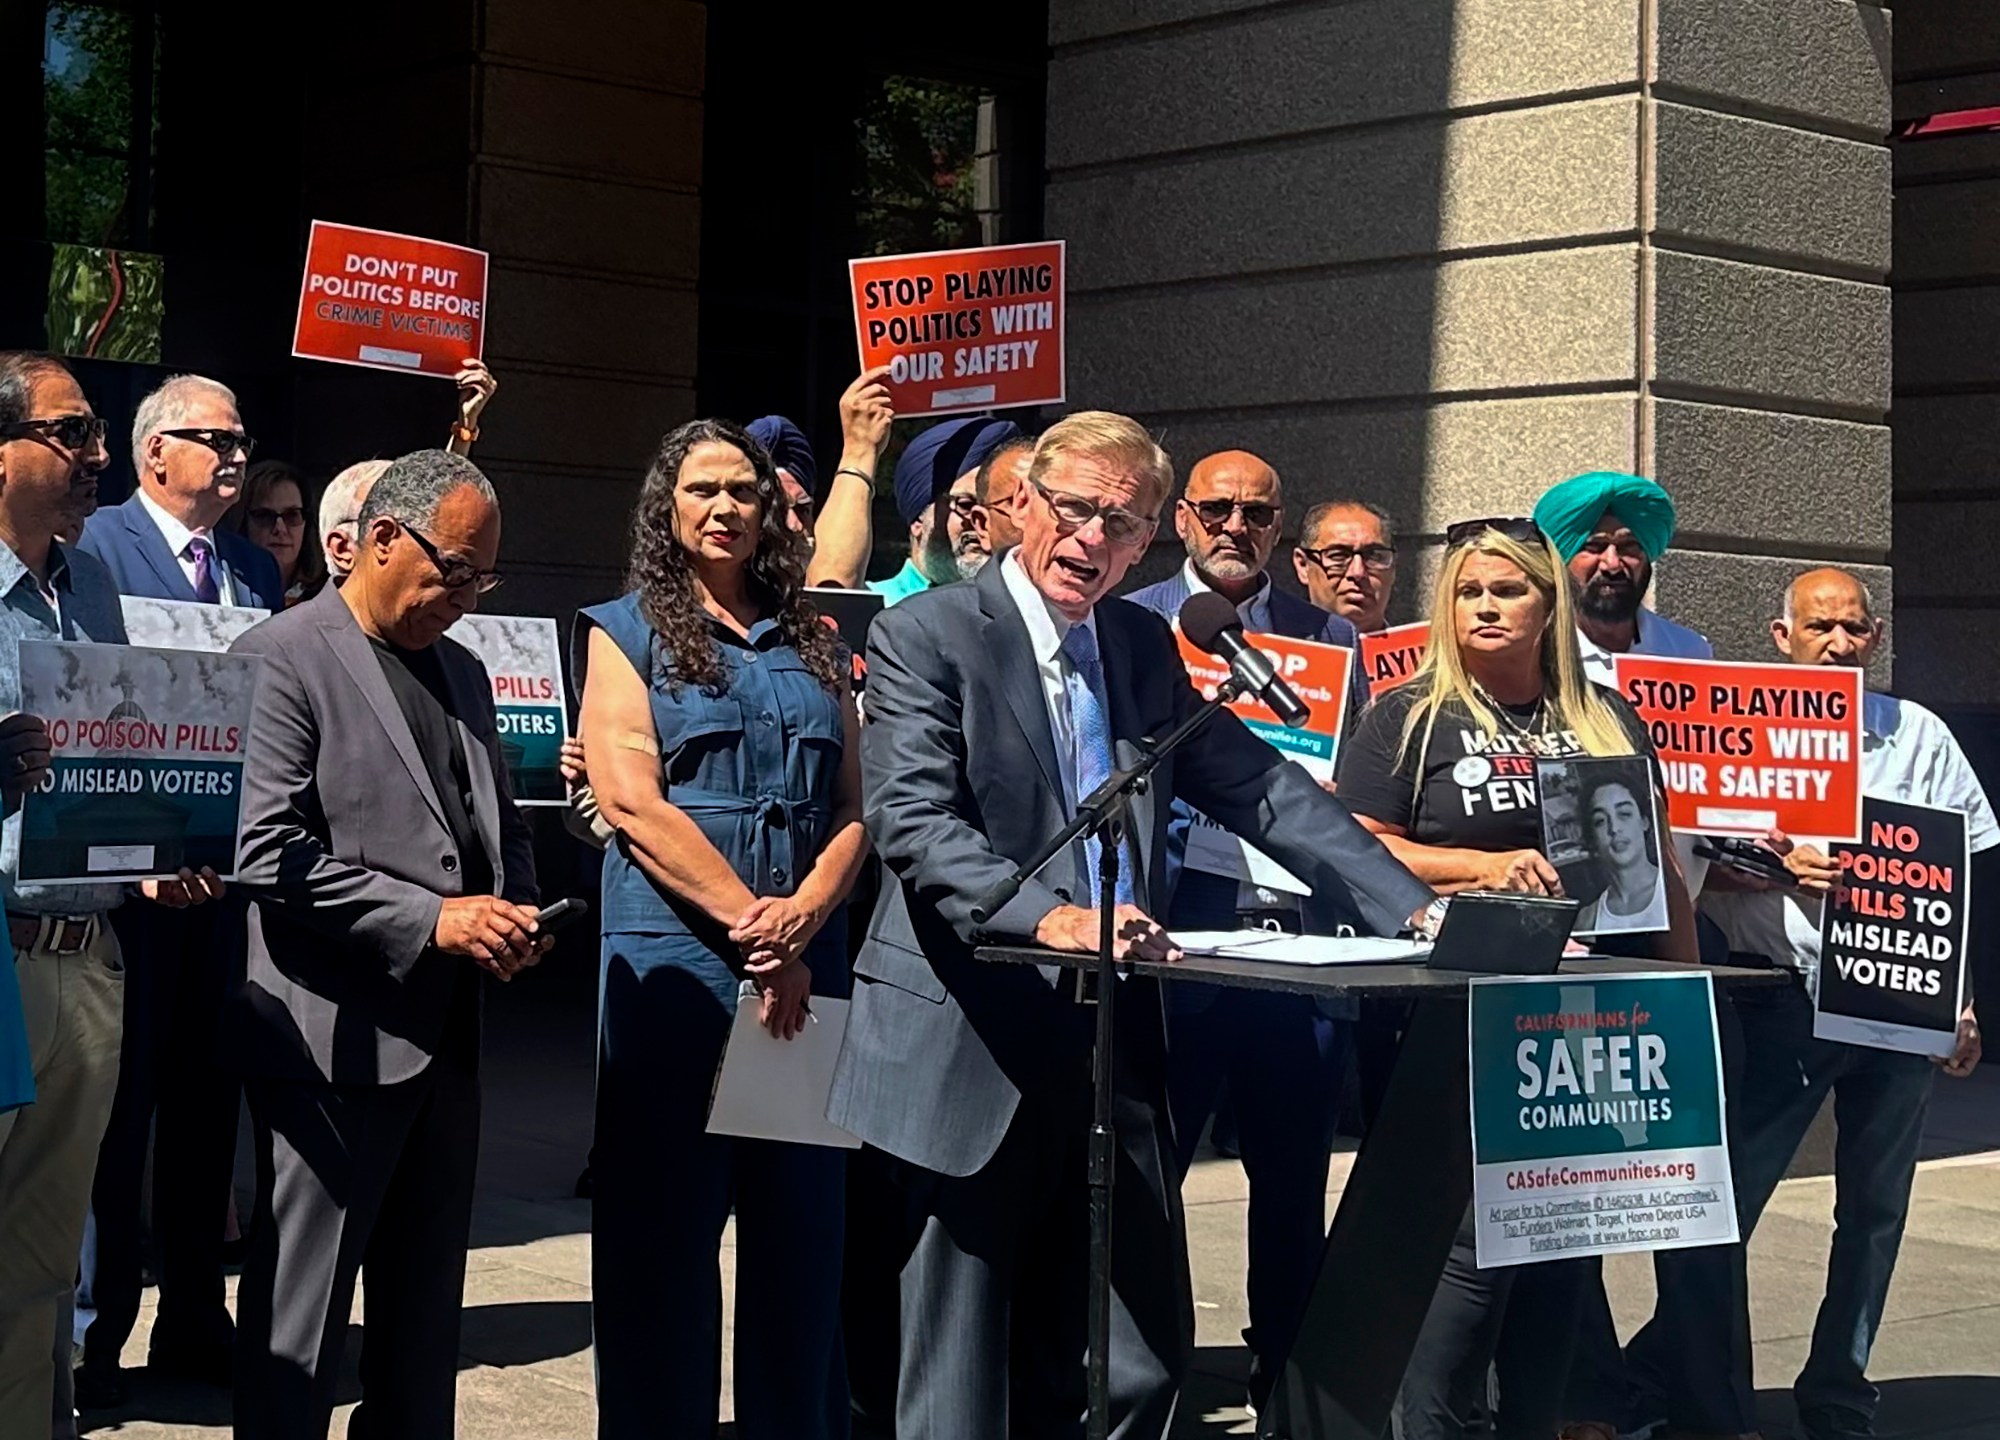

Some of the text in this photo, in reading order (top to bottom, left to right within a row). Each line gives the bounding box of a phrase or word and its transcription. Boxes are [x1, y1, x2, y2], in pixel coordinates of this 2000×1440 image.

[345, 253, 458, 289] DON'T PUT
[865, 264, 1052, 309] STOP PLAYING
[309, 274, 480, 319] POLITICS BEFORE
[316, 301, 472, 341] CRIME VICTIMS
[868, 301, 1053, 348] POLITICS WITH
[891, 339, 1039, 384] OUR SAFETY
[1369, 646, 1425, 681] AYI
[495, 676, 552, 700] PILLS
[1628, 679, 1847, 720] STOP PLAYING
[76, 720, 167, 750] POISON
[175, 724, 239, 754] PILLS
[496, 712, 556, 735] OTERS
[1767, 727, 1849, 762] WITH
[33, 768, 233, 795] O MISLEAD VOTERS
[1719, 764, 1832, 802] SAFETY
[1871, 820, 1920, 852] NO
[1838, 850, 1952, 893] POISON
[1835, 886, 1952, 926] PILLS TO
[1830, 920, 1952, 962] MISLEAD
[1835, 954, 1941, 996] VOTERS
[1515, 1001, 1651, 1035] CALIFORNIANS for
[1516, 1034, 1670, 1100] SAFER
[1519, 1097, 1673, 1131] COMMUNITIES
[1506, 1160, 1696, 1191] CASafeCommunities.org
[1502, 1222, 1518, 1238] Top
[1520, 1220, 1553, 1236] Funders
[1626, 1211, 1654, 1224] Home
[1656, 1208, 1684, 1223] Depot
[1685, 1206, 1707, 1218] USA
[1546, 1200, 1591, 1216] Committee
[1530, 1236, 1562, 1251] Funding
